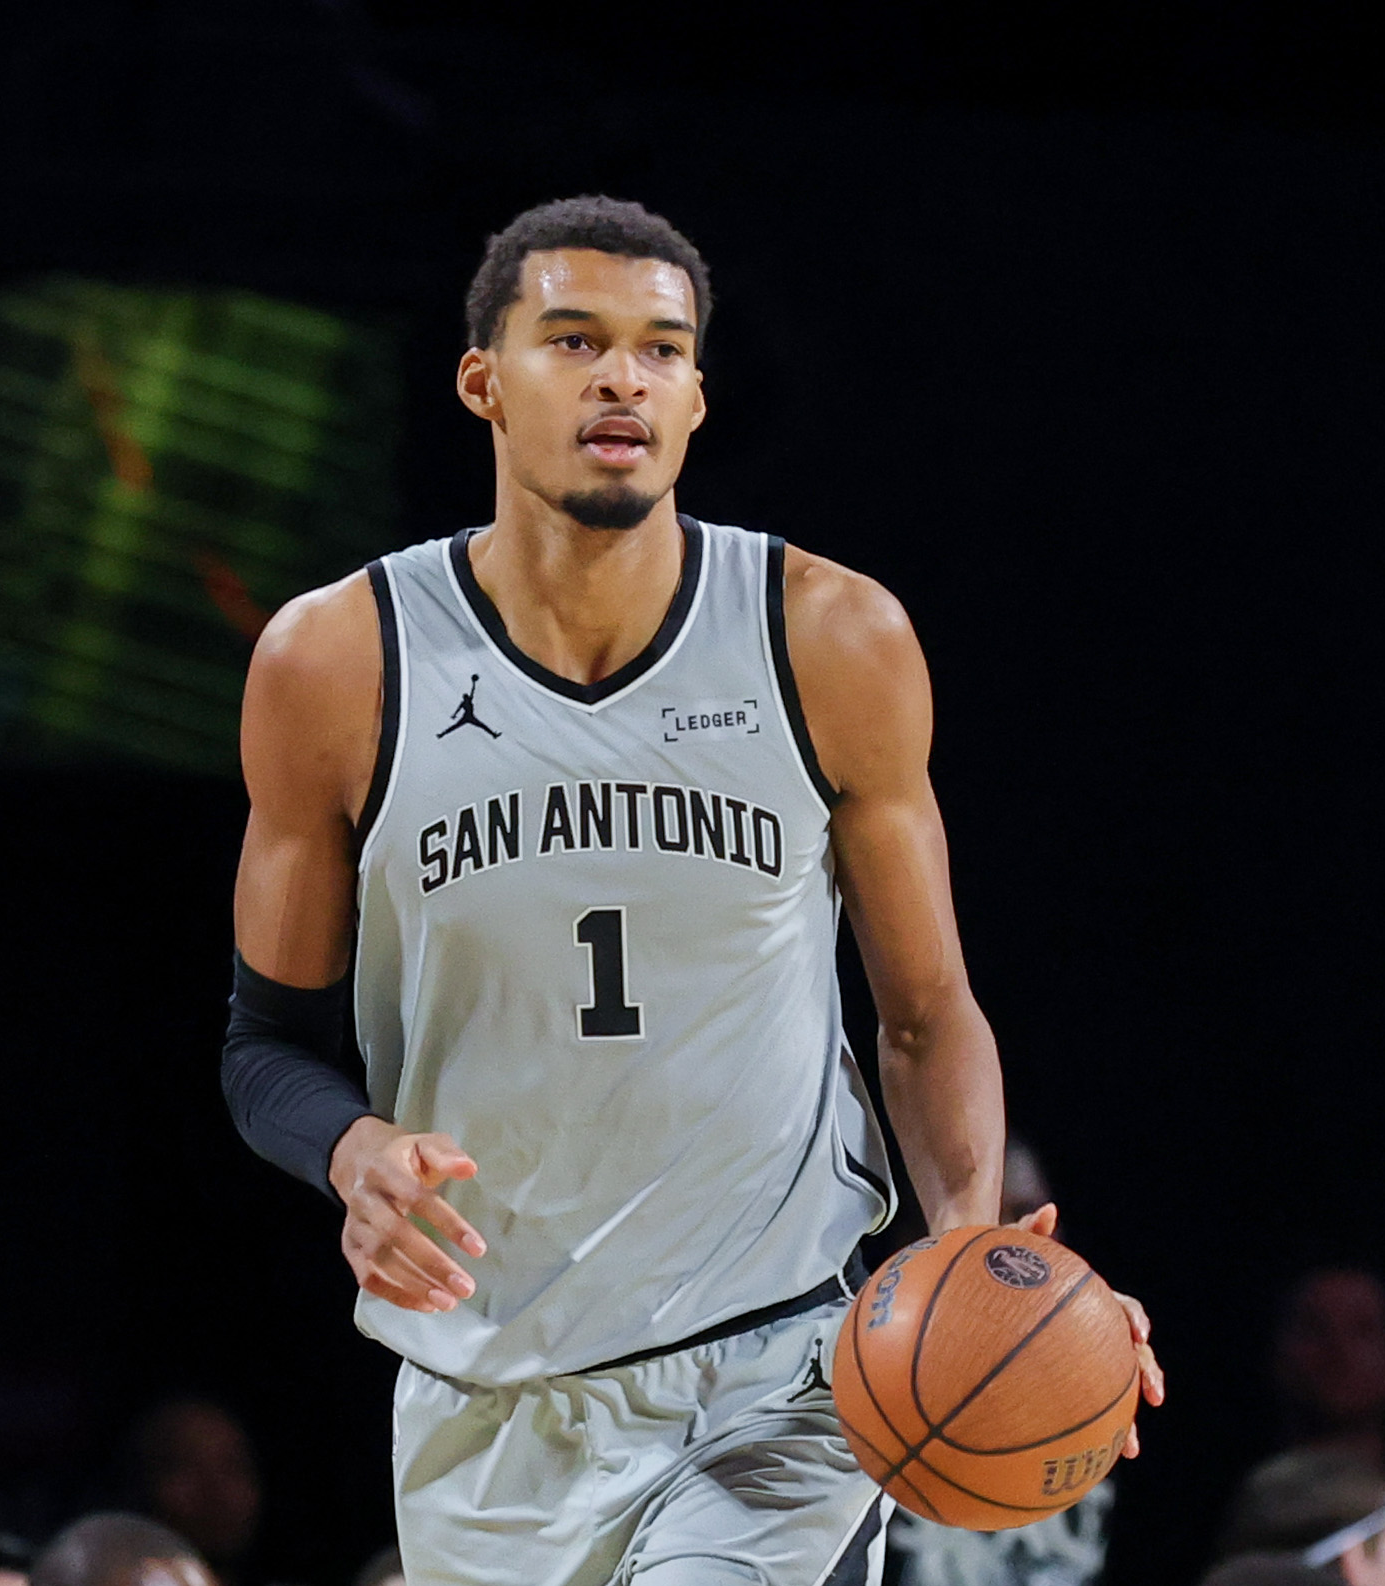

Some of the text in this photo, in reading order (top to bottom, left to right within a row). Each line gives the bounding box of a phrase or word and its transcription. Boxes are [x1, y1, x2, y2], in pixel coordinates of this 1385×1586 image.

[674, 711, 748, 733] LEDGER
[418, 779, 785, 896] SAN ANTONIO
[572, 906, 646, 1041] 1
